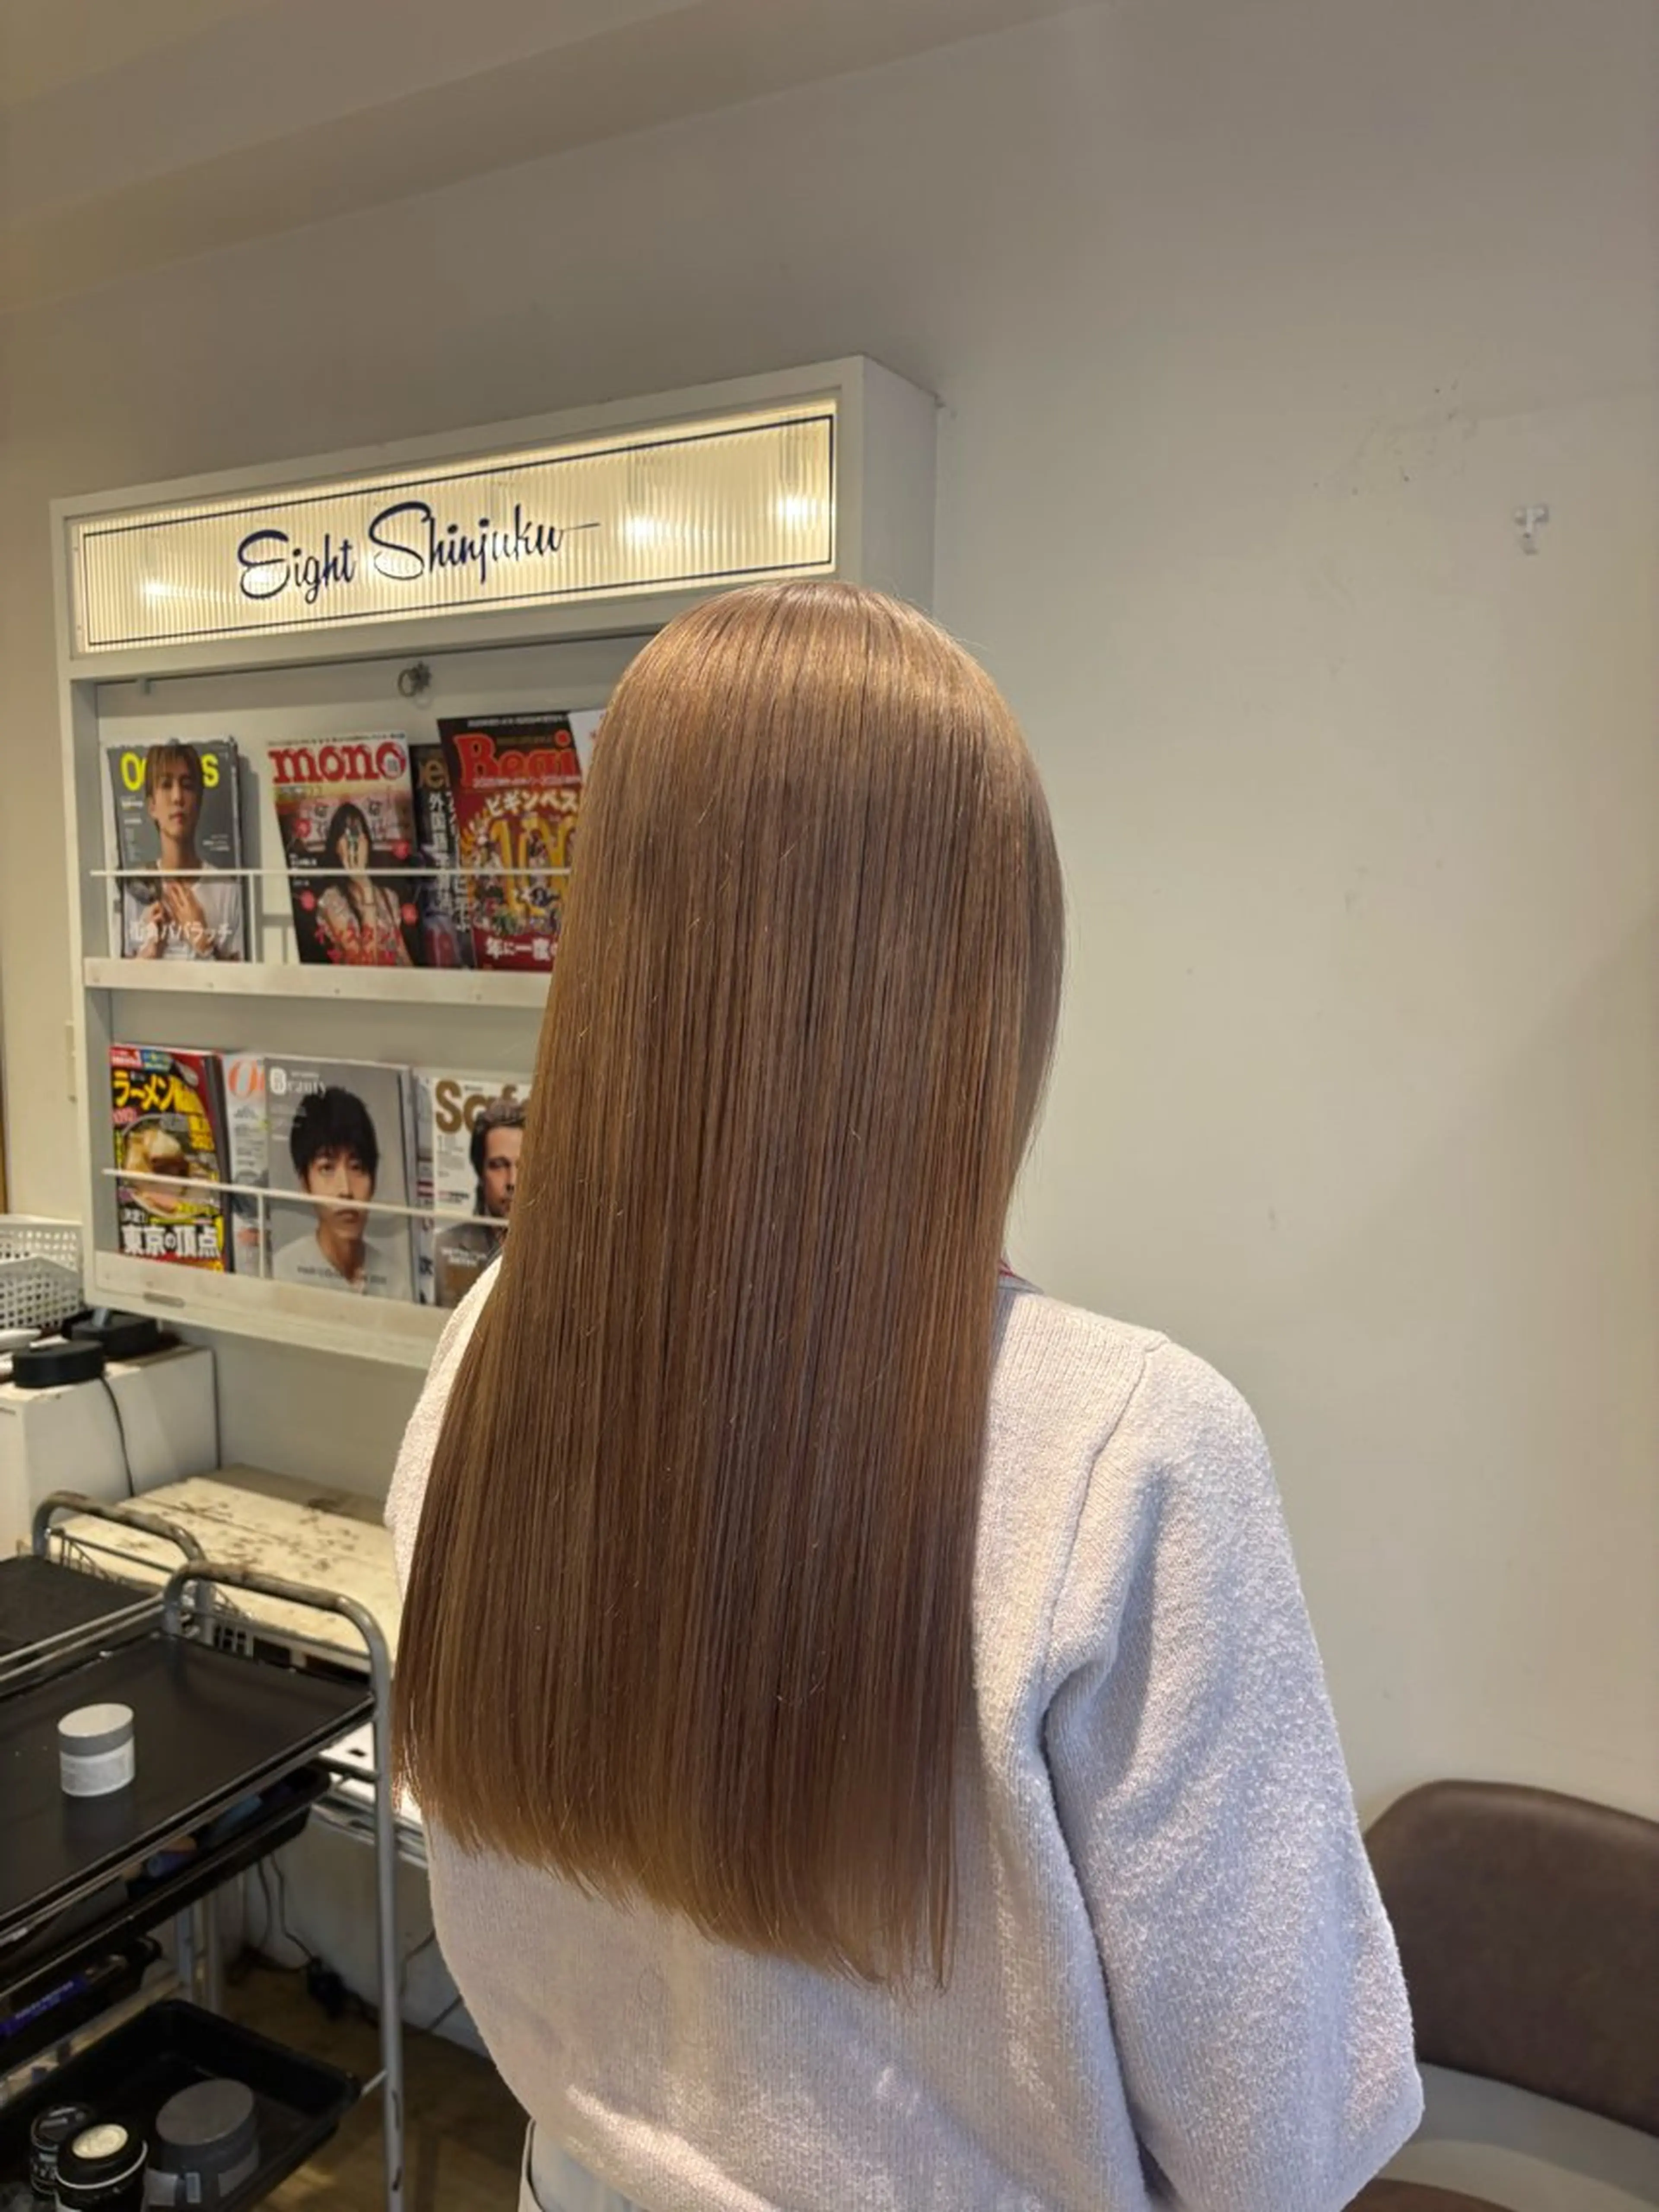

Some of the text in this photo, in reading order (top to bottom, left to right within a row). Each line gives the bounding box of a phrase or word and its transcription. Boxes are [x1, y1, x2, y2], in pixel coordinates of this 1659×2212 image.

[237, 500, 600, 604] Eight Shinjuku
[268, 741, 407, 784] mono
